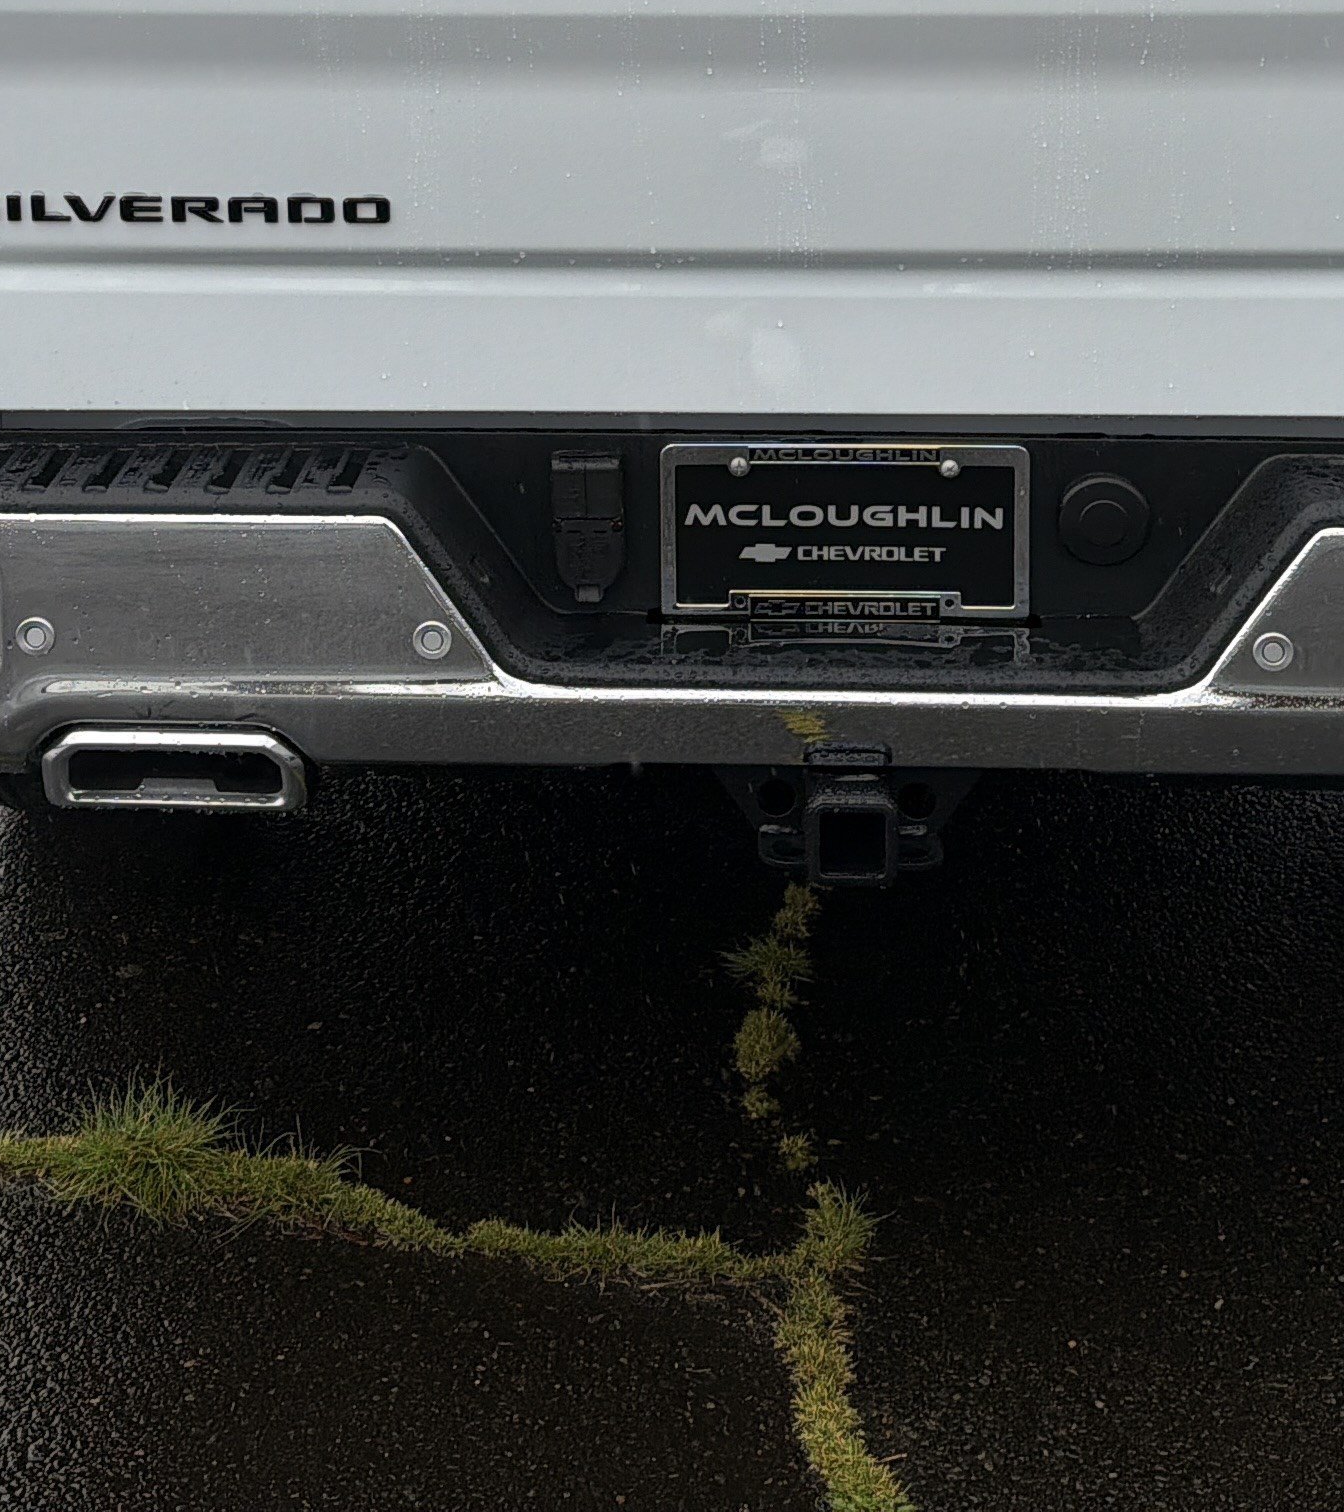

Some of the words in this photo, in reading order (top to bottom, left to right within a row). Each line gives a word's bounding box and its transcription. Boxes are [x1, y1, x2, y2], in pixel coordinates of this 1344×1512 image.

[754, 449, 936, 461] MCLOUGHLIN
[684, 504, 1003, 529] MCLOUGHLIN
[797, 545, 946, 562] CHEVROLET
[805, 602, 936, 616] CHEVROLET
